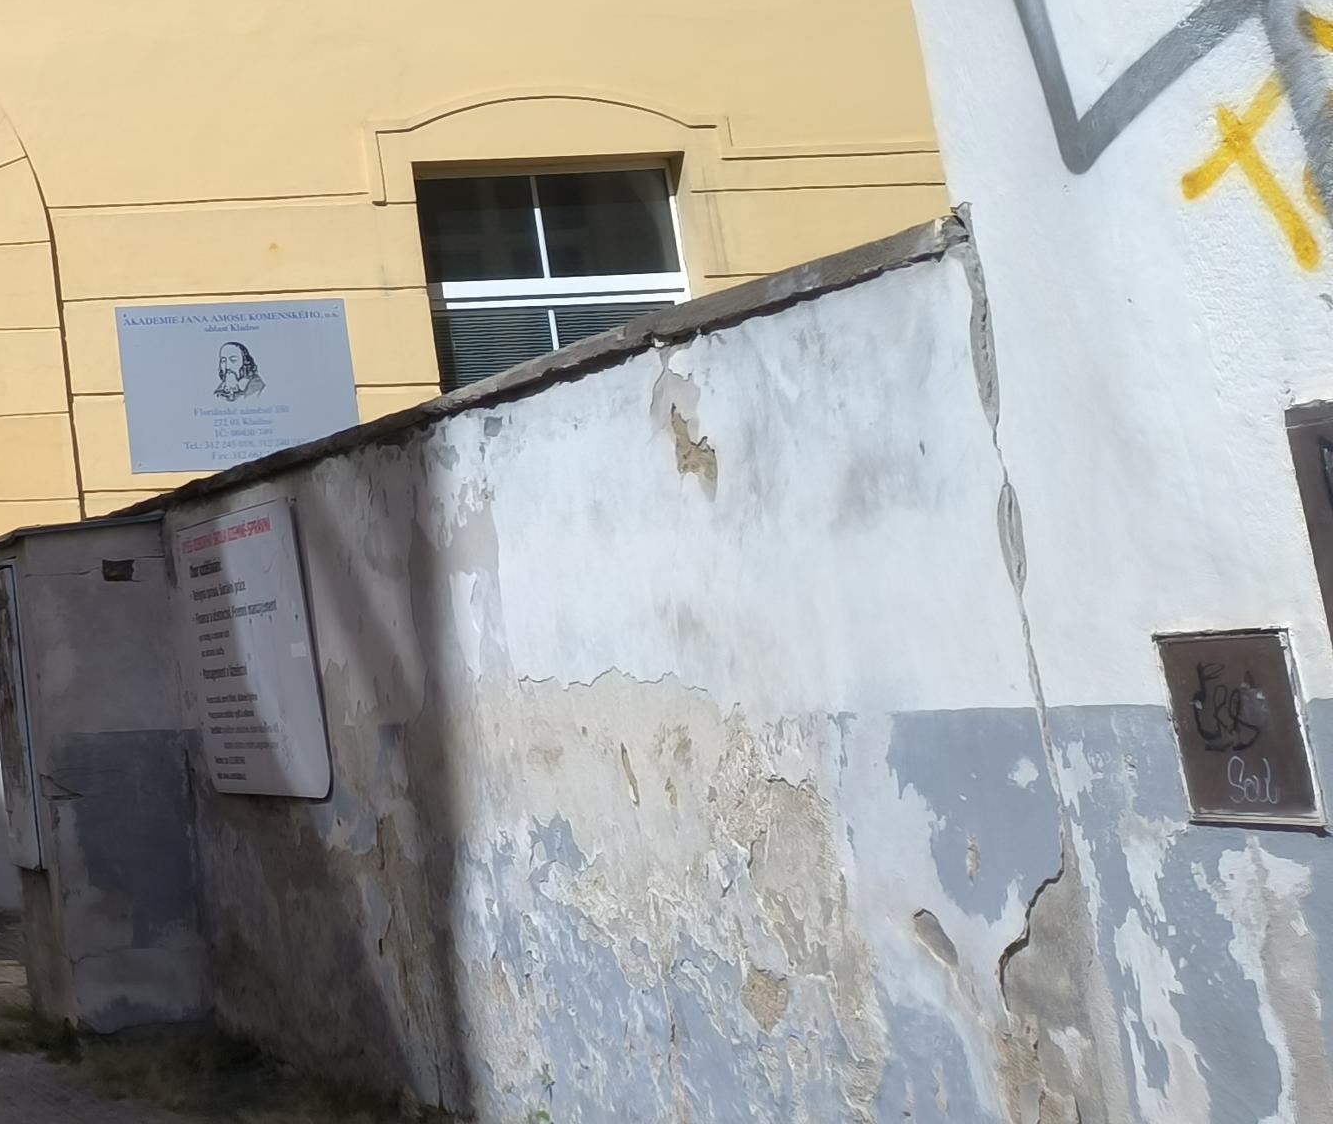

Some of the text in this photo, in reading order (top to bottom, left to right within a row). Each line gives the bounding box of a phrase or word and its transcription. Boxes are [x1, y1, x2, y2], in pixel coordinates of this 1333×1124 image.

[123, 315, 176, 326] AKADEMIE
[180, 314, 209, 324] JANA
[230, 322, 260, 332] Kladno
